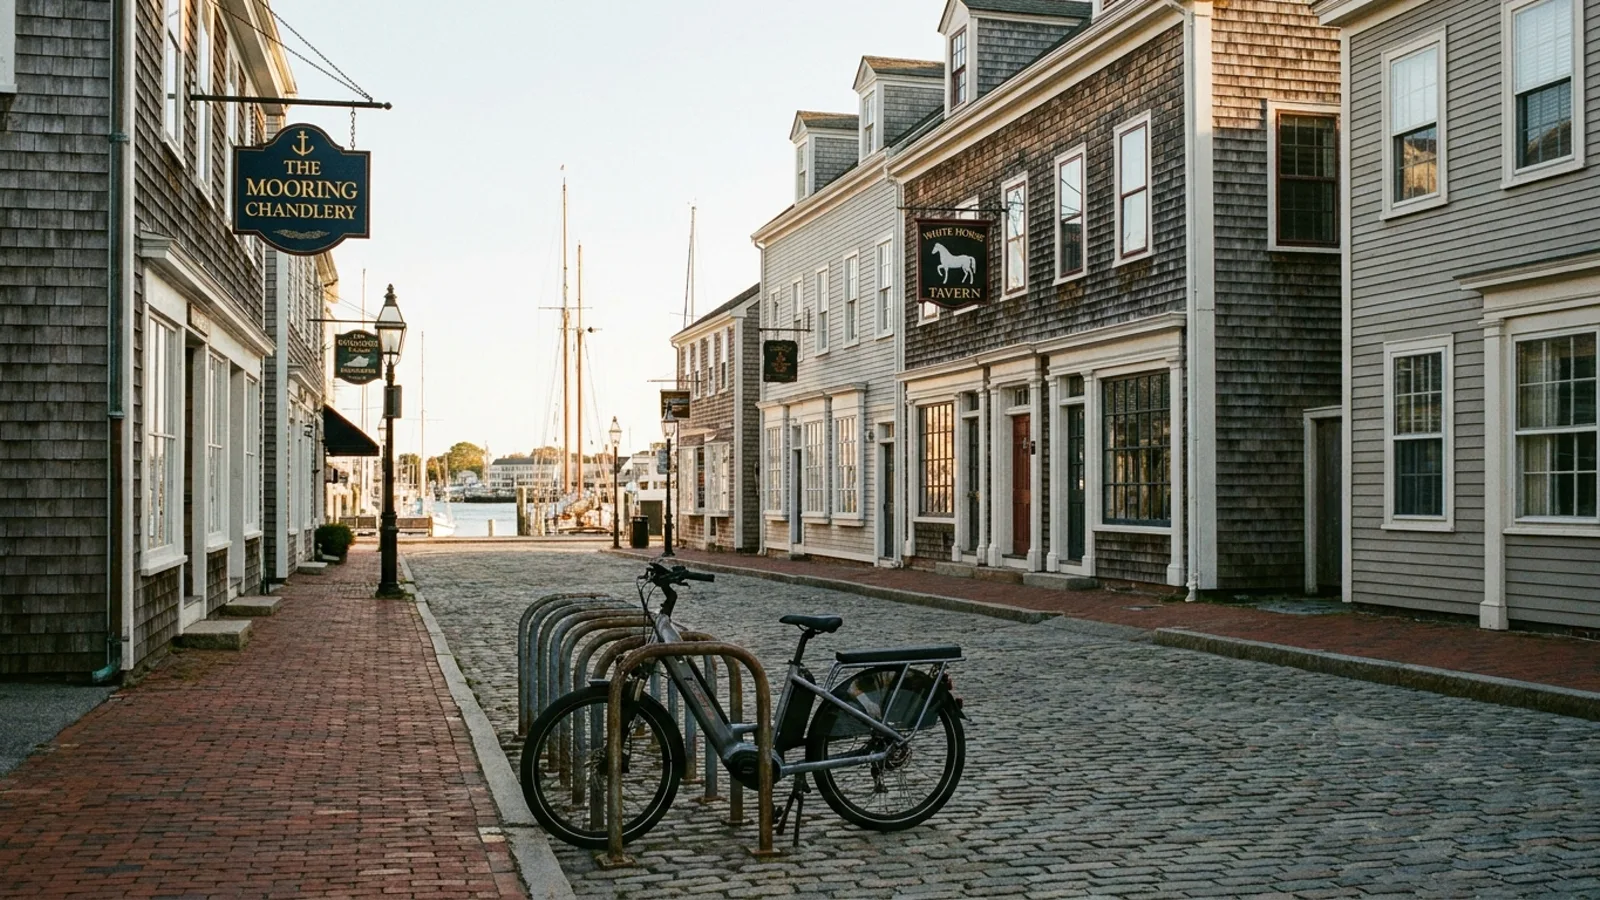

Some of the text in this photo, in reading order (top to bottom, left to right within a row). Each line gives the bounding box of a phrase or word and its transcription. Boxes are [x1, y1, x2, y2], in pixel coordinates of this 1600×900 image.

[284, 160, 321, 175] THE
[246, 178, 358, 199] MOORING
[245, 202, 357, 219] CHANDLERY
[923, 227, 953, 240] WHITE
[929, 287, 980, 299] TAVERN
